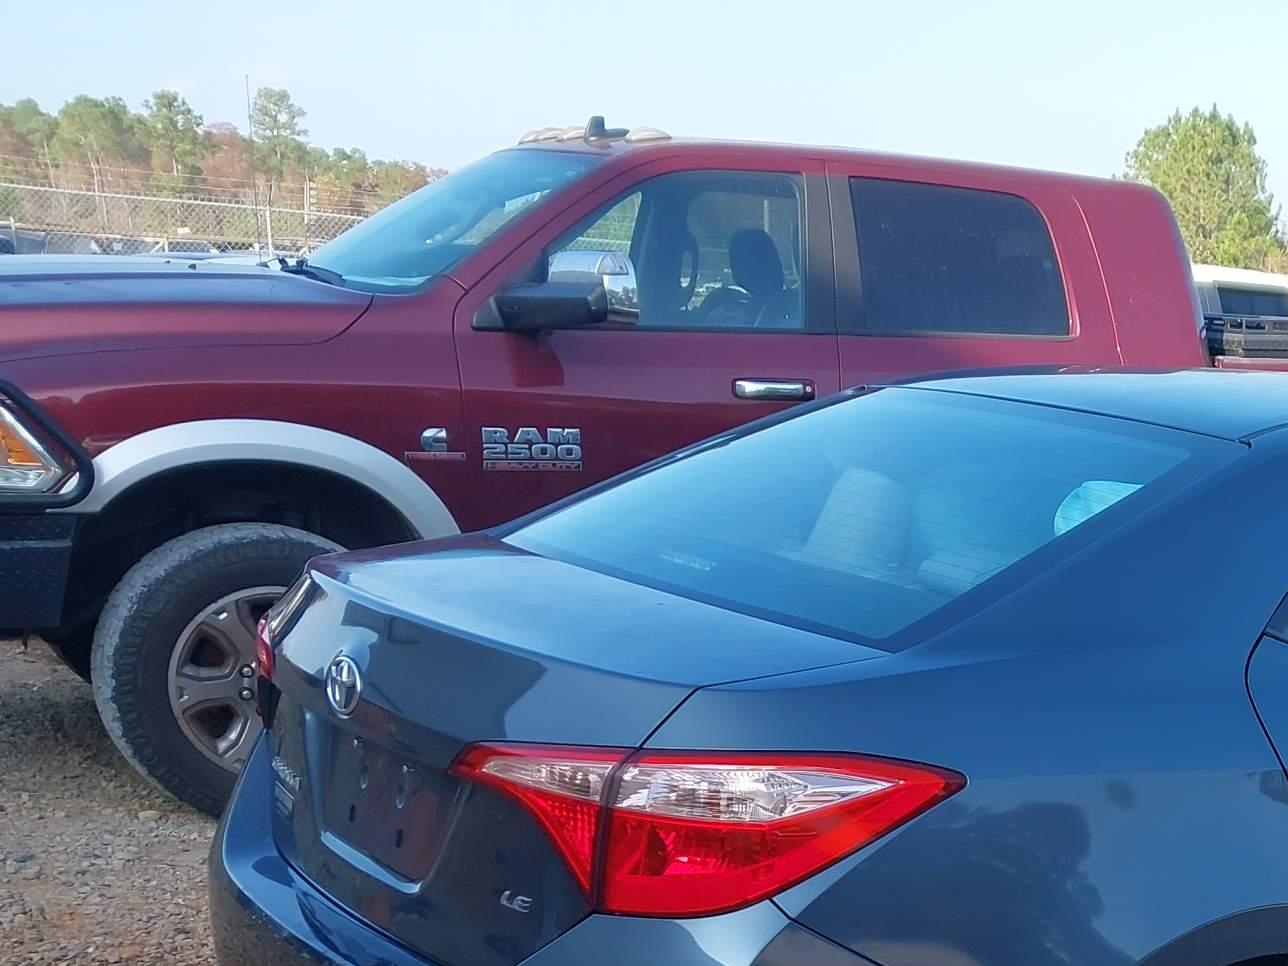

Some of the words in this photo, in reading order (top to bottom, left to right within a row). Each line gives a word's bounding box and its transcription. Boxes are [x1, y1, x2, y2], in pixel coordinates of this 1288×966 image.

[481, 427, 581, 443] RAM
[483, 443, 582, 460] 2500
[500, 890, 533, 913] LE
